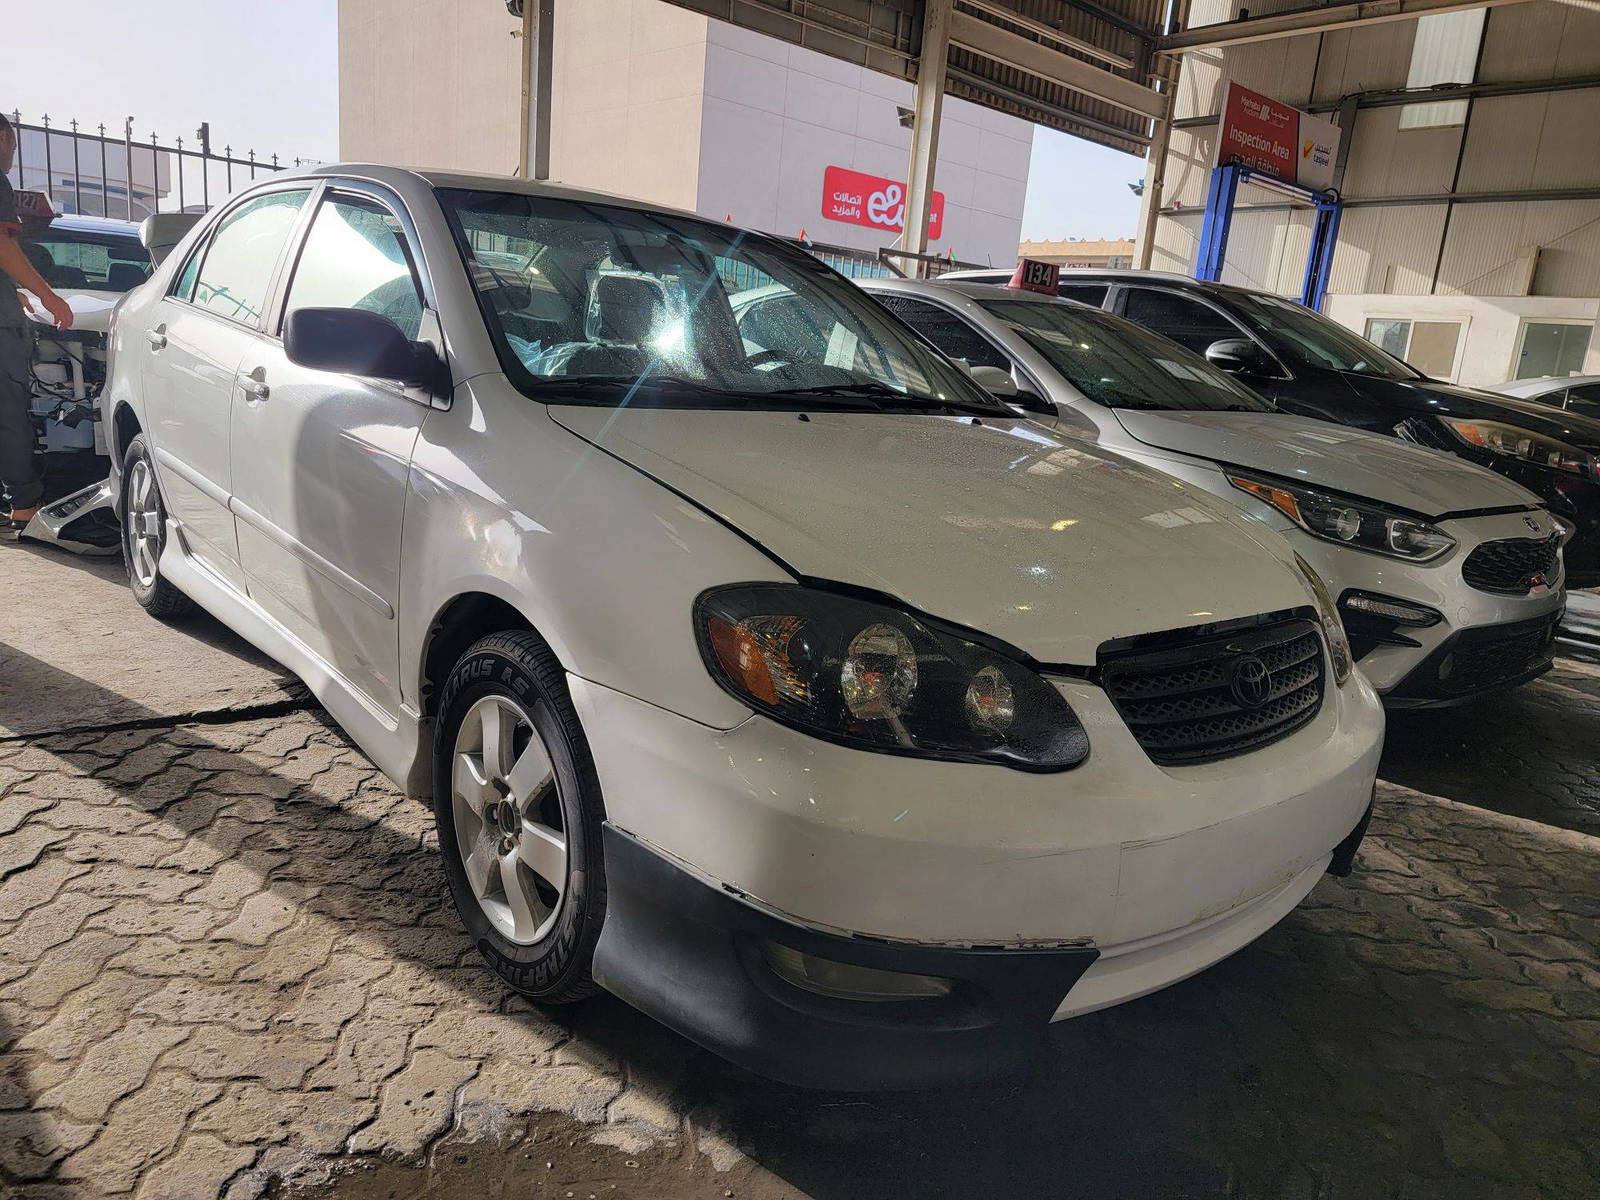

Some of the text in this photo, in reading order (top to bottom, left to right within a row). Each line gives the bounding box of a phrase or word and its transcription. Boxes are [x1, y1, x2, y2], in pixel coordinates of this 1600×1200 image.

[1229, 123, 1290, 160] Inspection Area
[833, 191, 862, 206] اتصالات
[832, 205, 861, 219] والمزيد
[1027, 263, 1053, 286] 134
